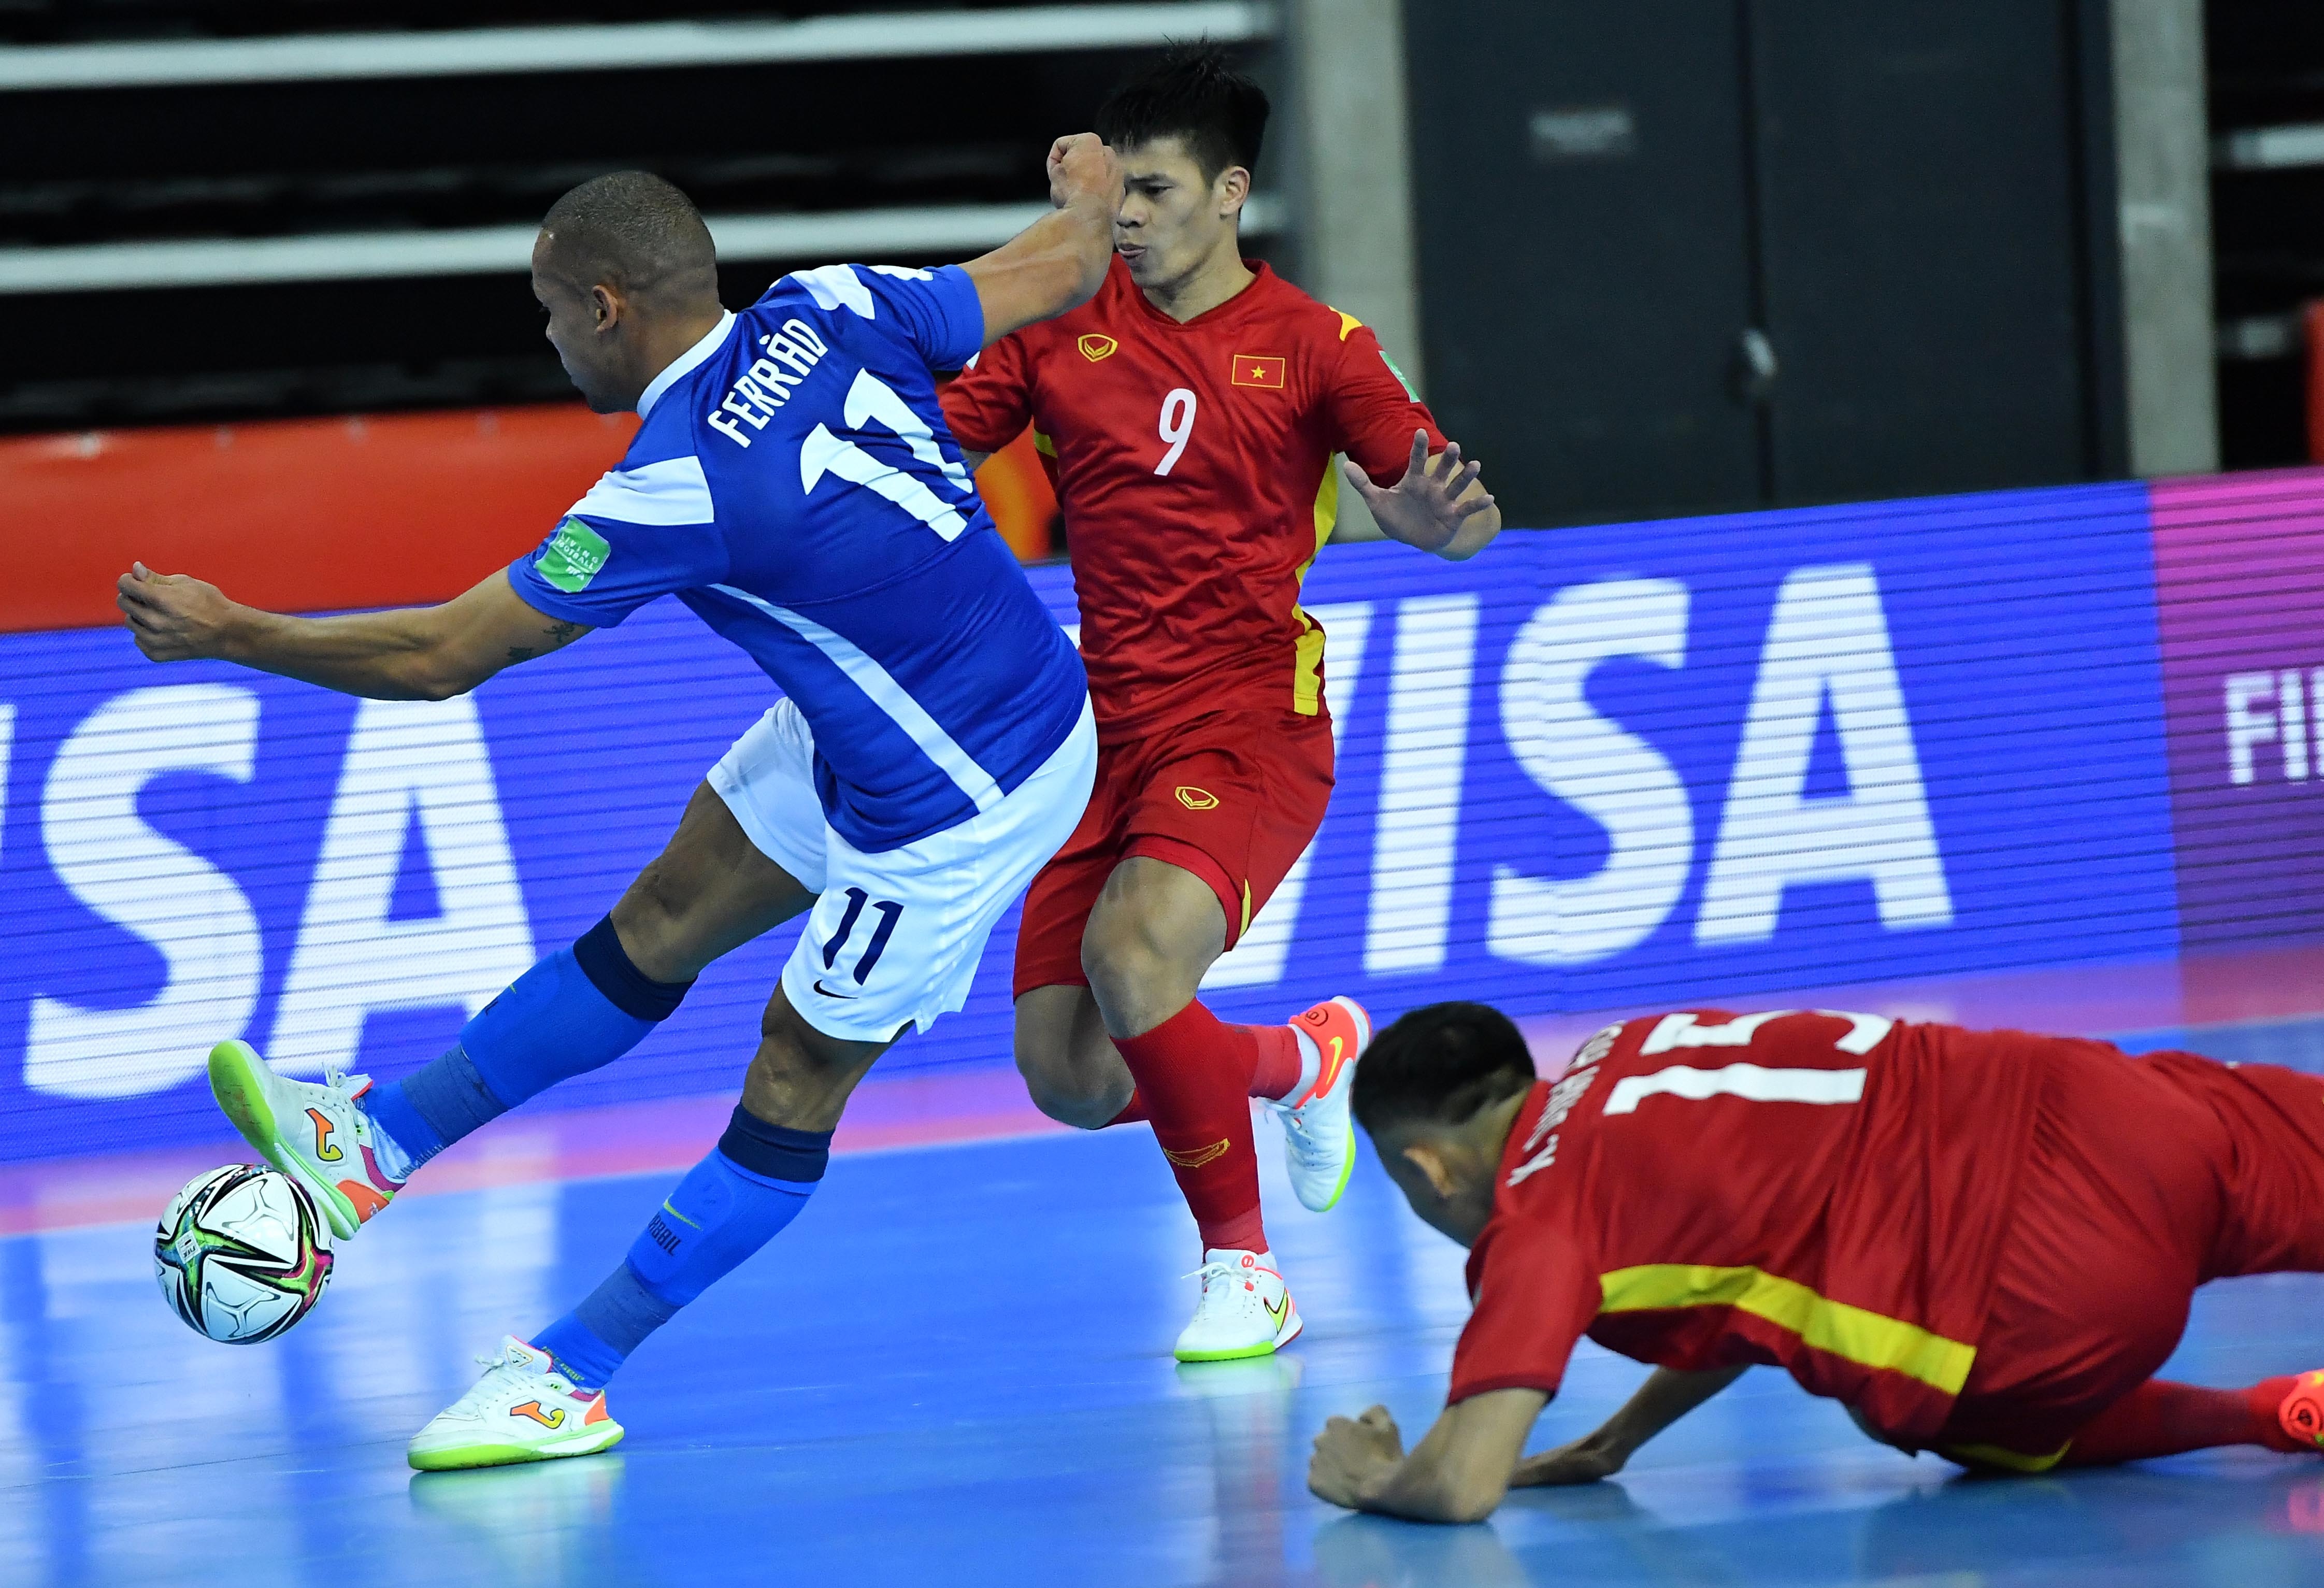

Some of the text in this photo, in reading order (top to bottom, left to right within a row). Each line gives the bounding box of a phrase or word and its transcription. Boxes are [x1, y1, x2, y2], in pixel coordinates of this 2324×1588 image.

[800, 367, 973, 542] 11
[1154, 388, 1197, 476] 9
[556, 539, 594, 570] FOOTBALL
[561, 532, 599, 564] LIVING
[0, 683, 537, 1100] SA
[822, 886, 905, 986] 11
[1602, 1009, 1893, 1117] 15
